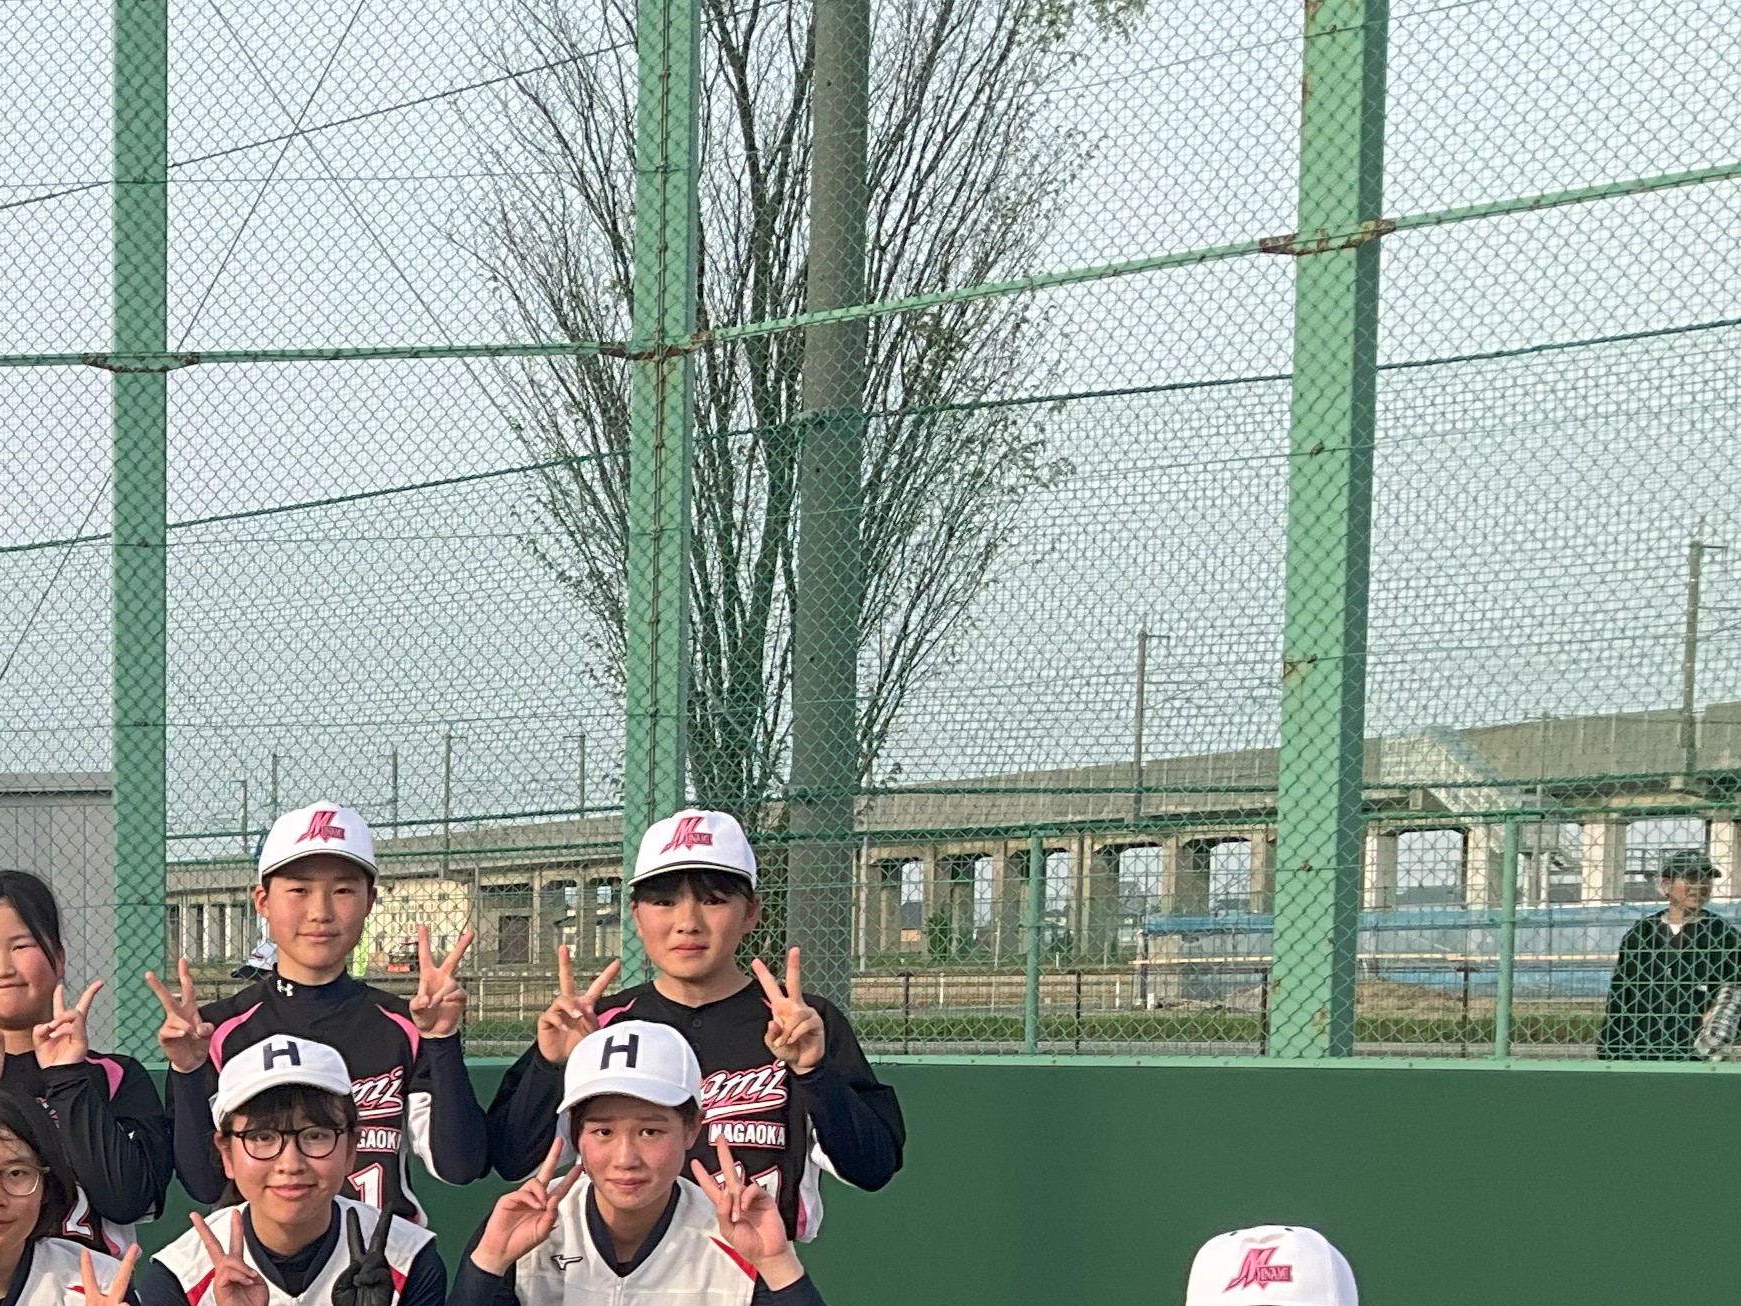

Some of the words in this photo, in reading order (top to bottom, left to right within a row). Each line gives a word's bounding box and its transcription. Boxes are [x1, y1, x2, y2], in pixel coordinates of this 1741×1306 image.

[263, 1040, 301, 1071] H
[600, 1033, 639, 1070] H
[710, 1122, 786, 1146] NAGAOKA
